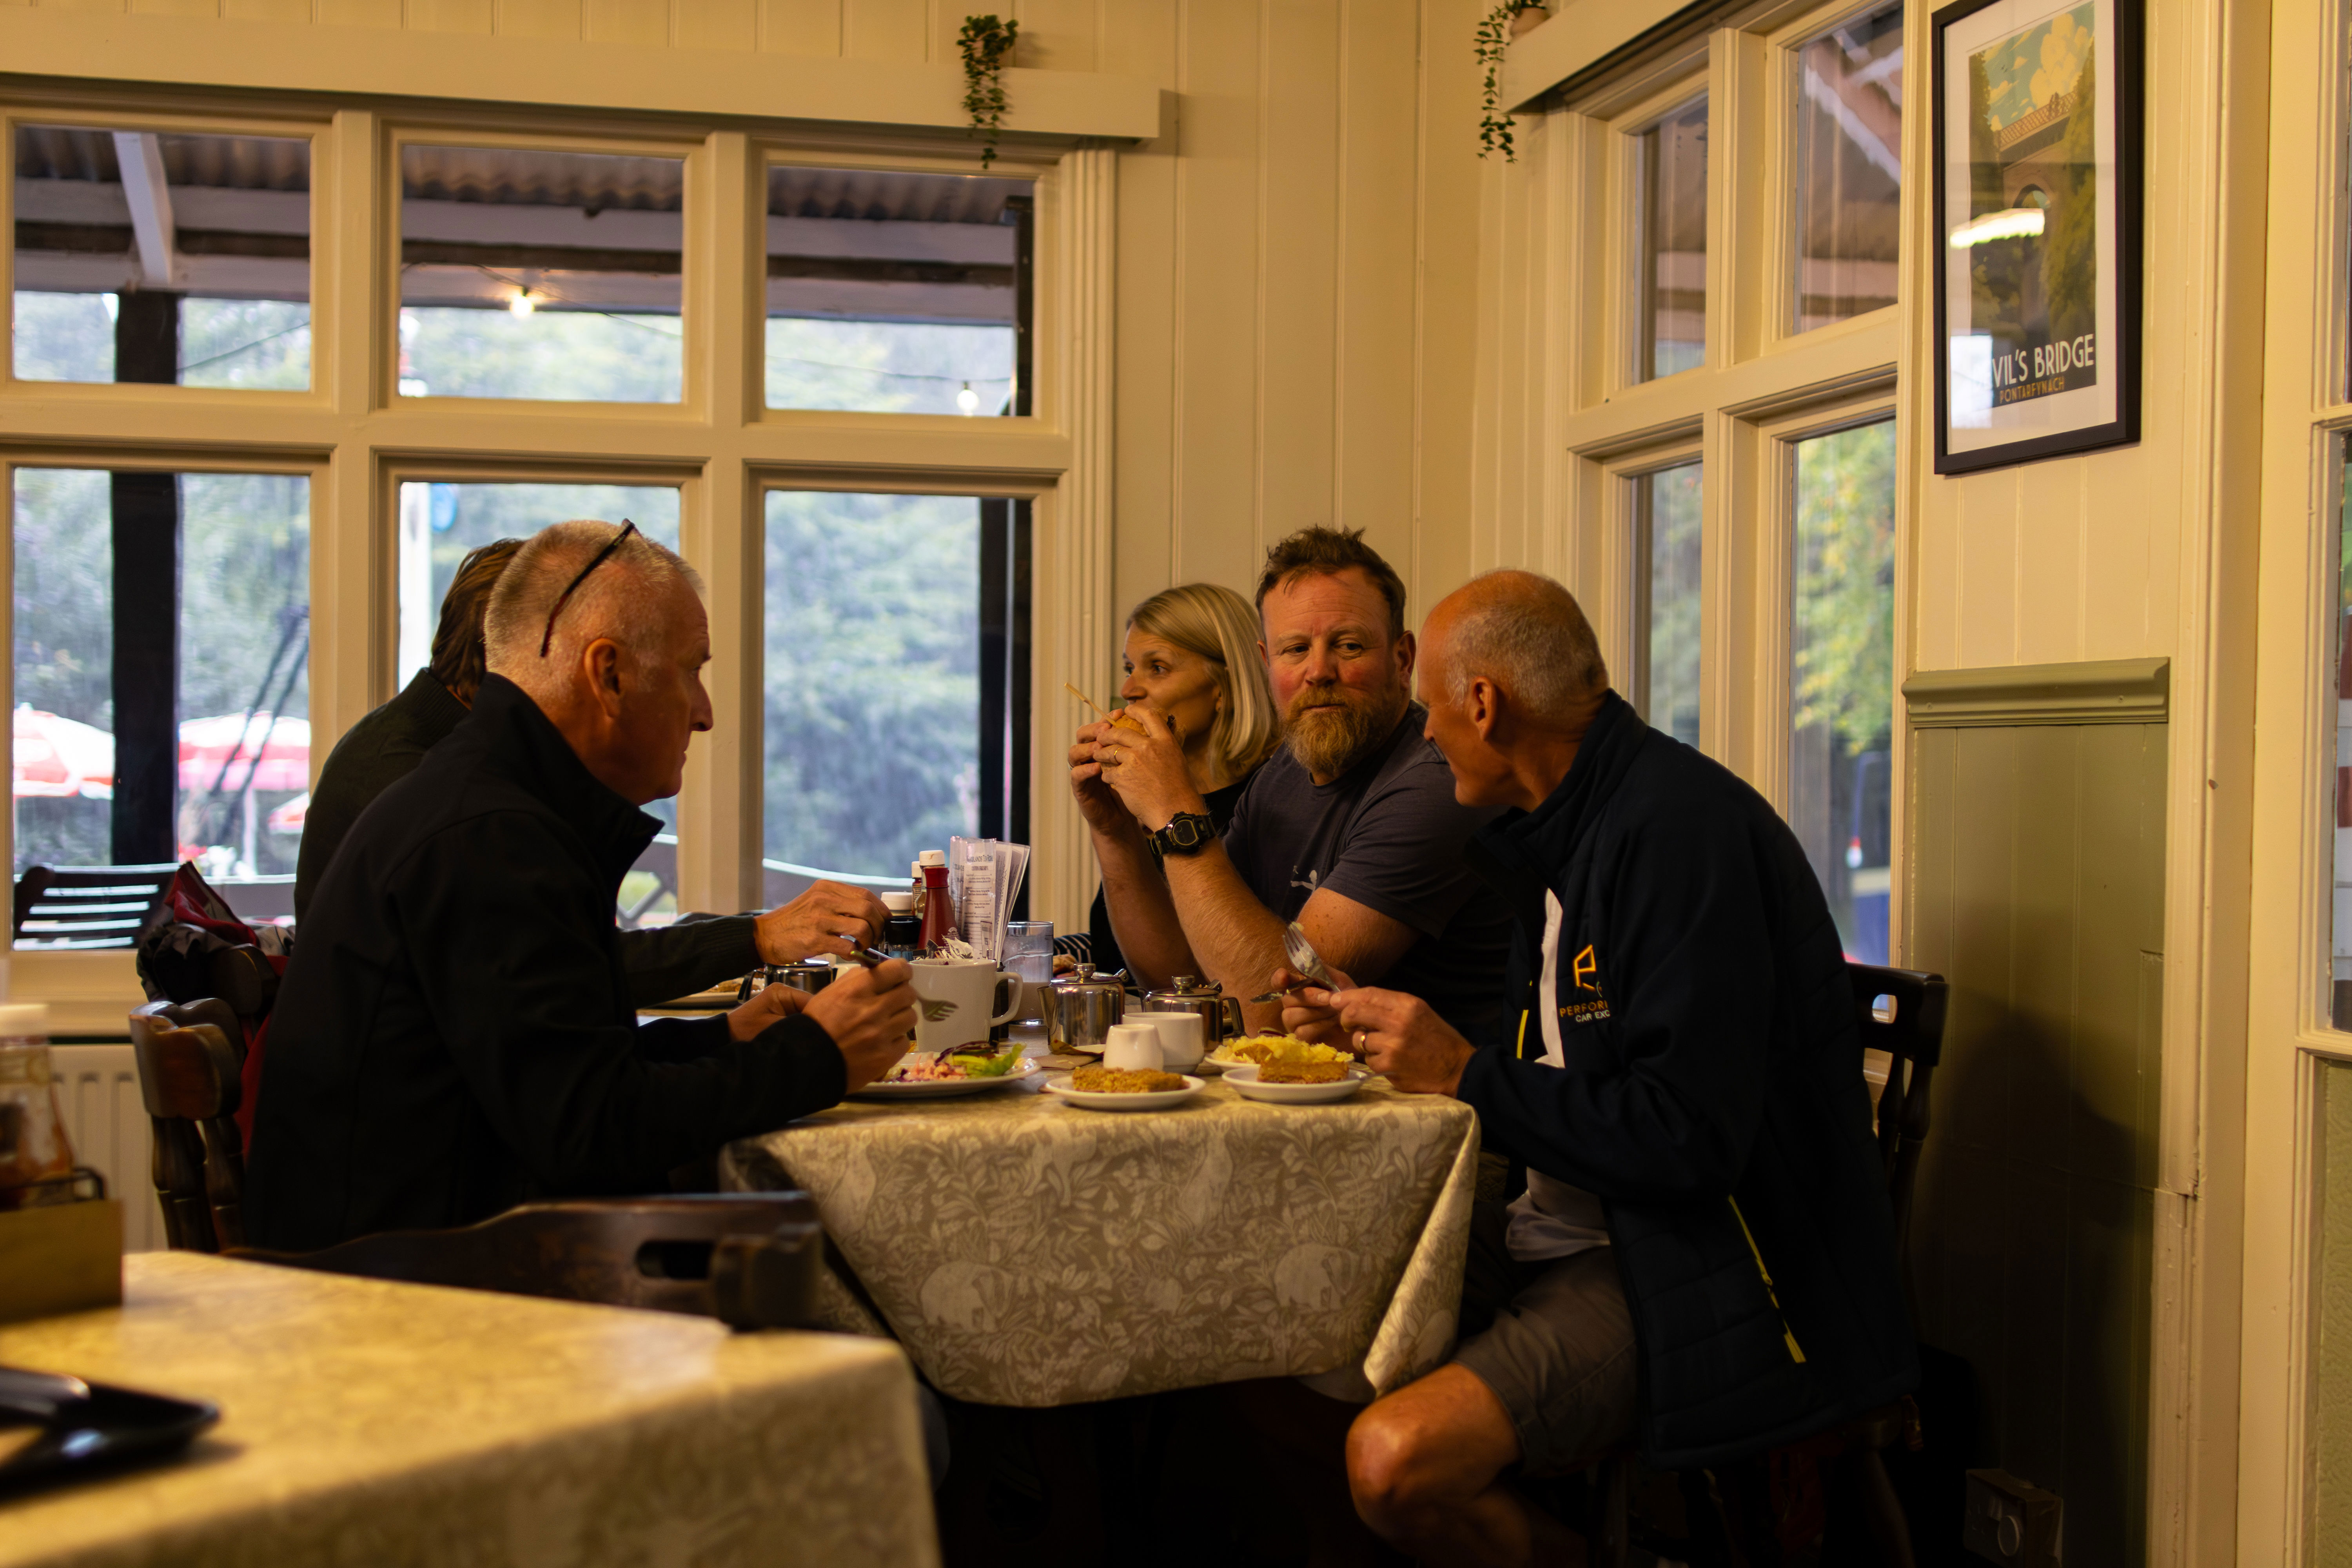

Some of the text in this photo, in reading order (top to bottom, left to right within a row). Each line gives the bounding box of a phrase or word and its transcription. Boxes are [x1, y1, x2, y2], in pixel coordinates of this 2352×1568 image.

[1992, 333, 2094, 388] VIL'S BRIDGE
[2000, 376, 2065, 404] PONTARFYNACH
[1575, 1013, 1593, 1022] CAR
